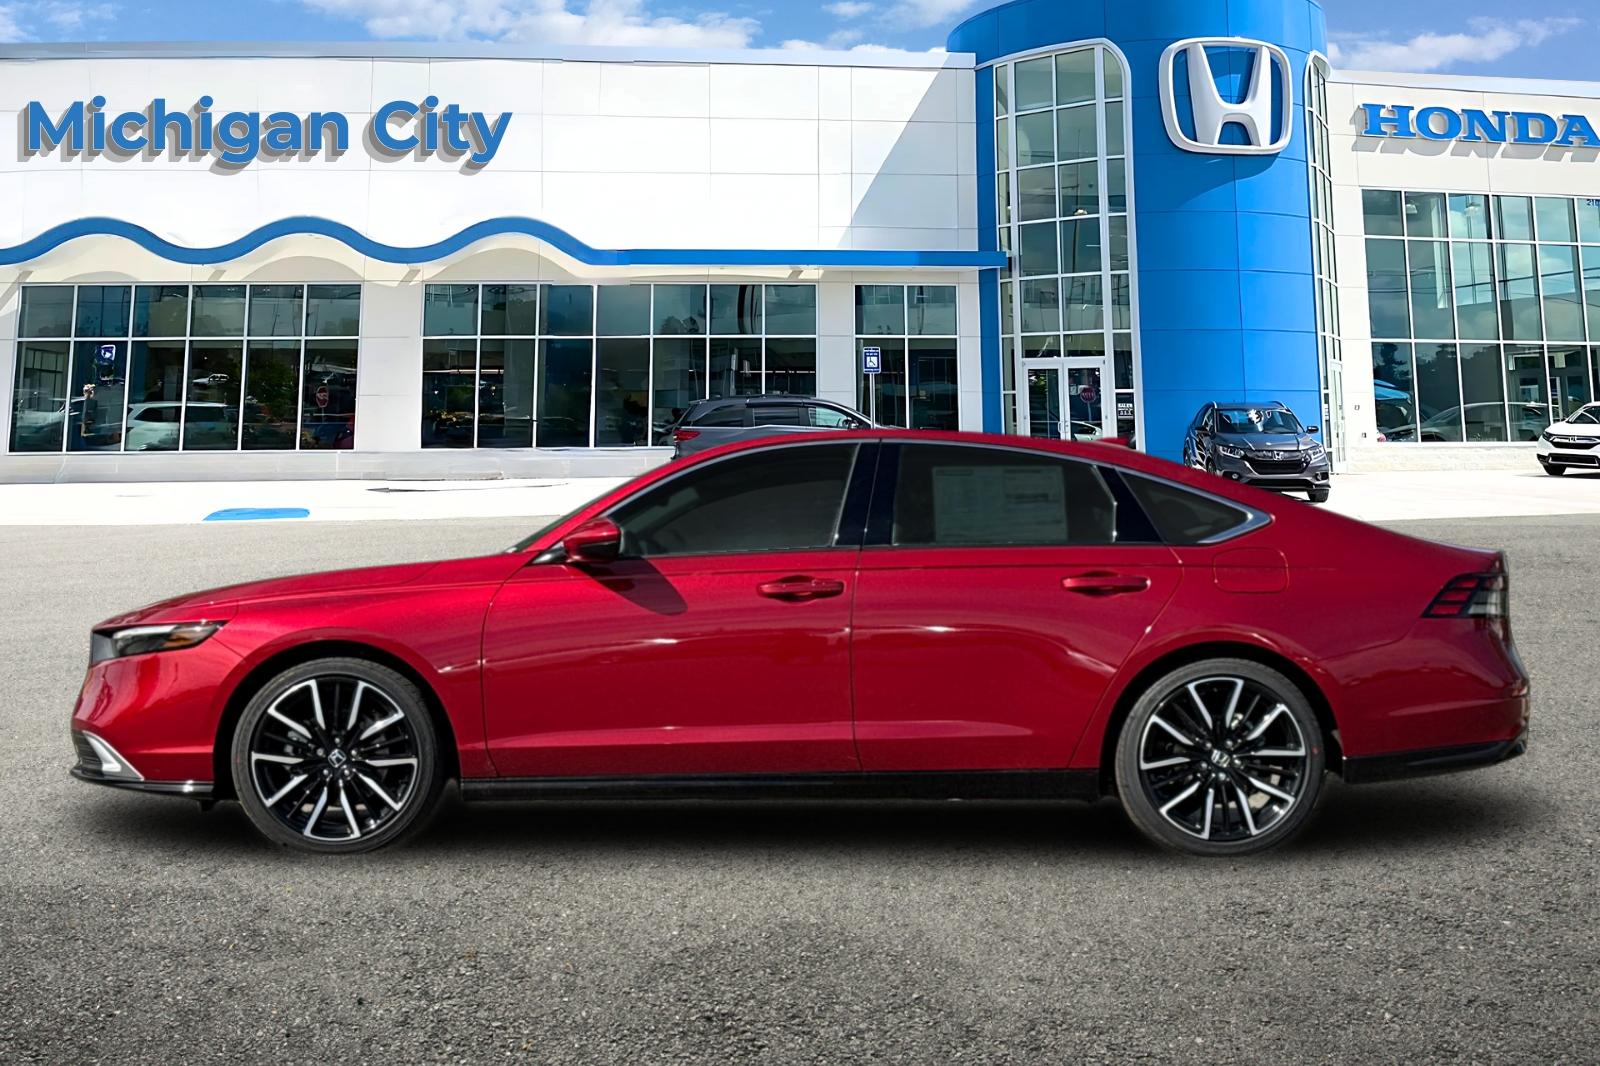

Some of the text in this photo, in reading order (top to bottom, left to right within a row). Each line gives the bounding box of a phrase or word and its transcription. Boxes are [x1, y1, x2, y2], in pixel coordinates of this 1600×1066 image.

[28, 95, 514, 165] Michigan City
[1361, 103, 1600, 148] HONDA
